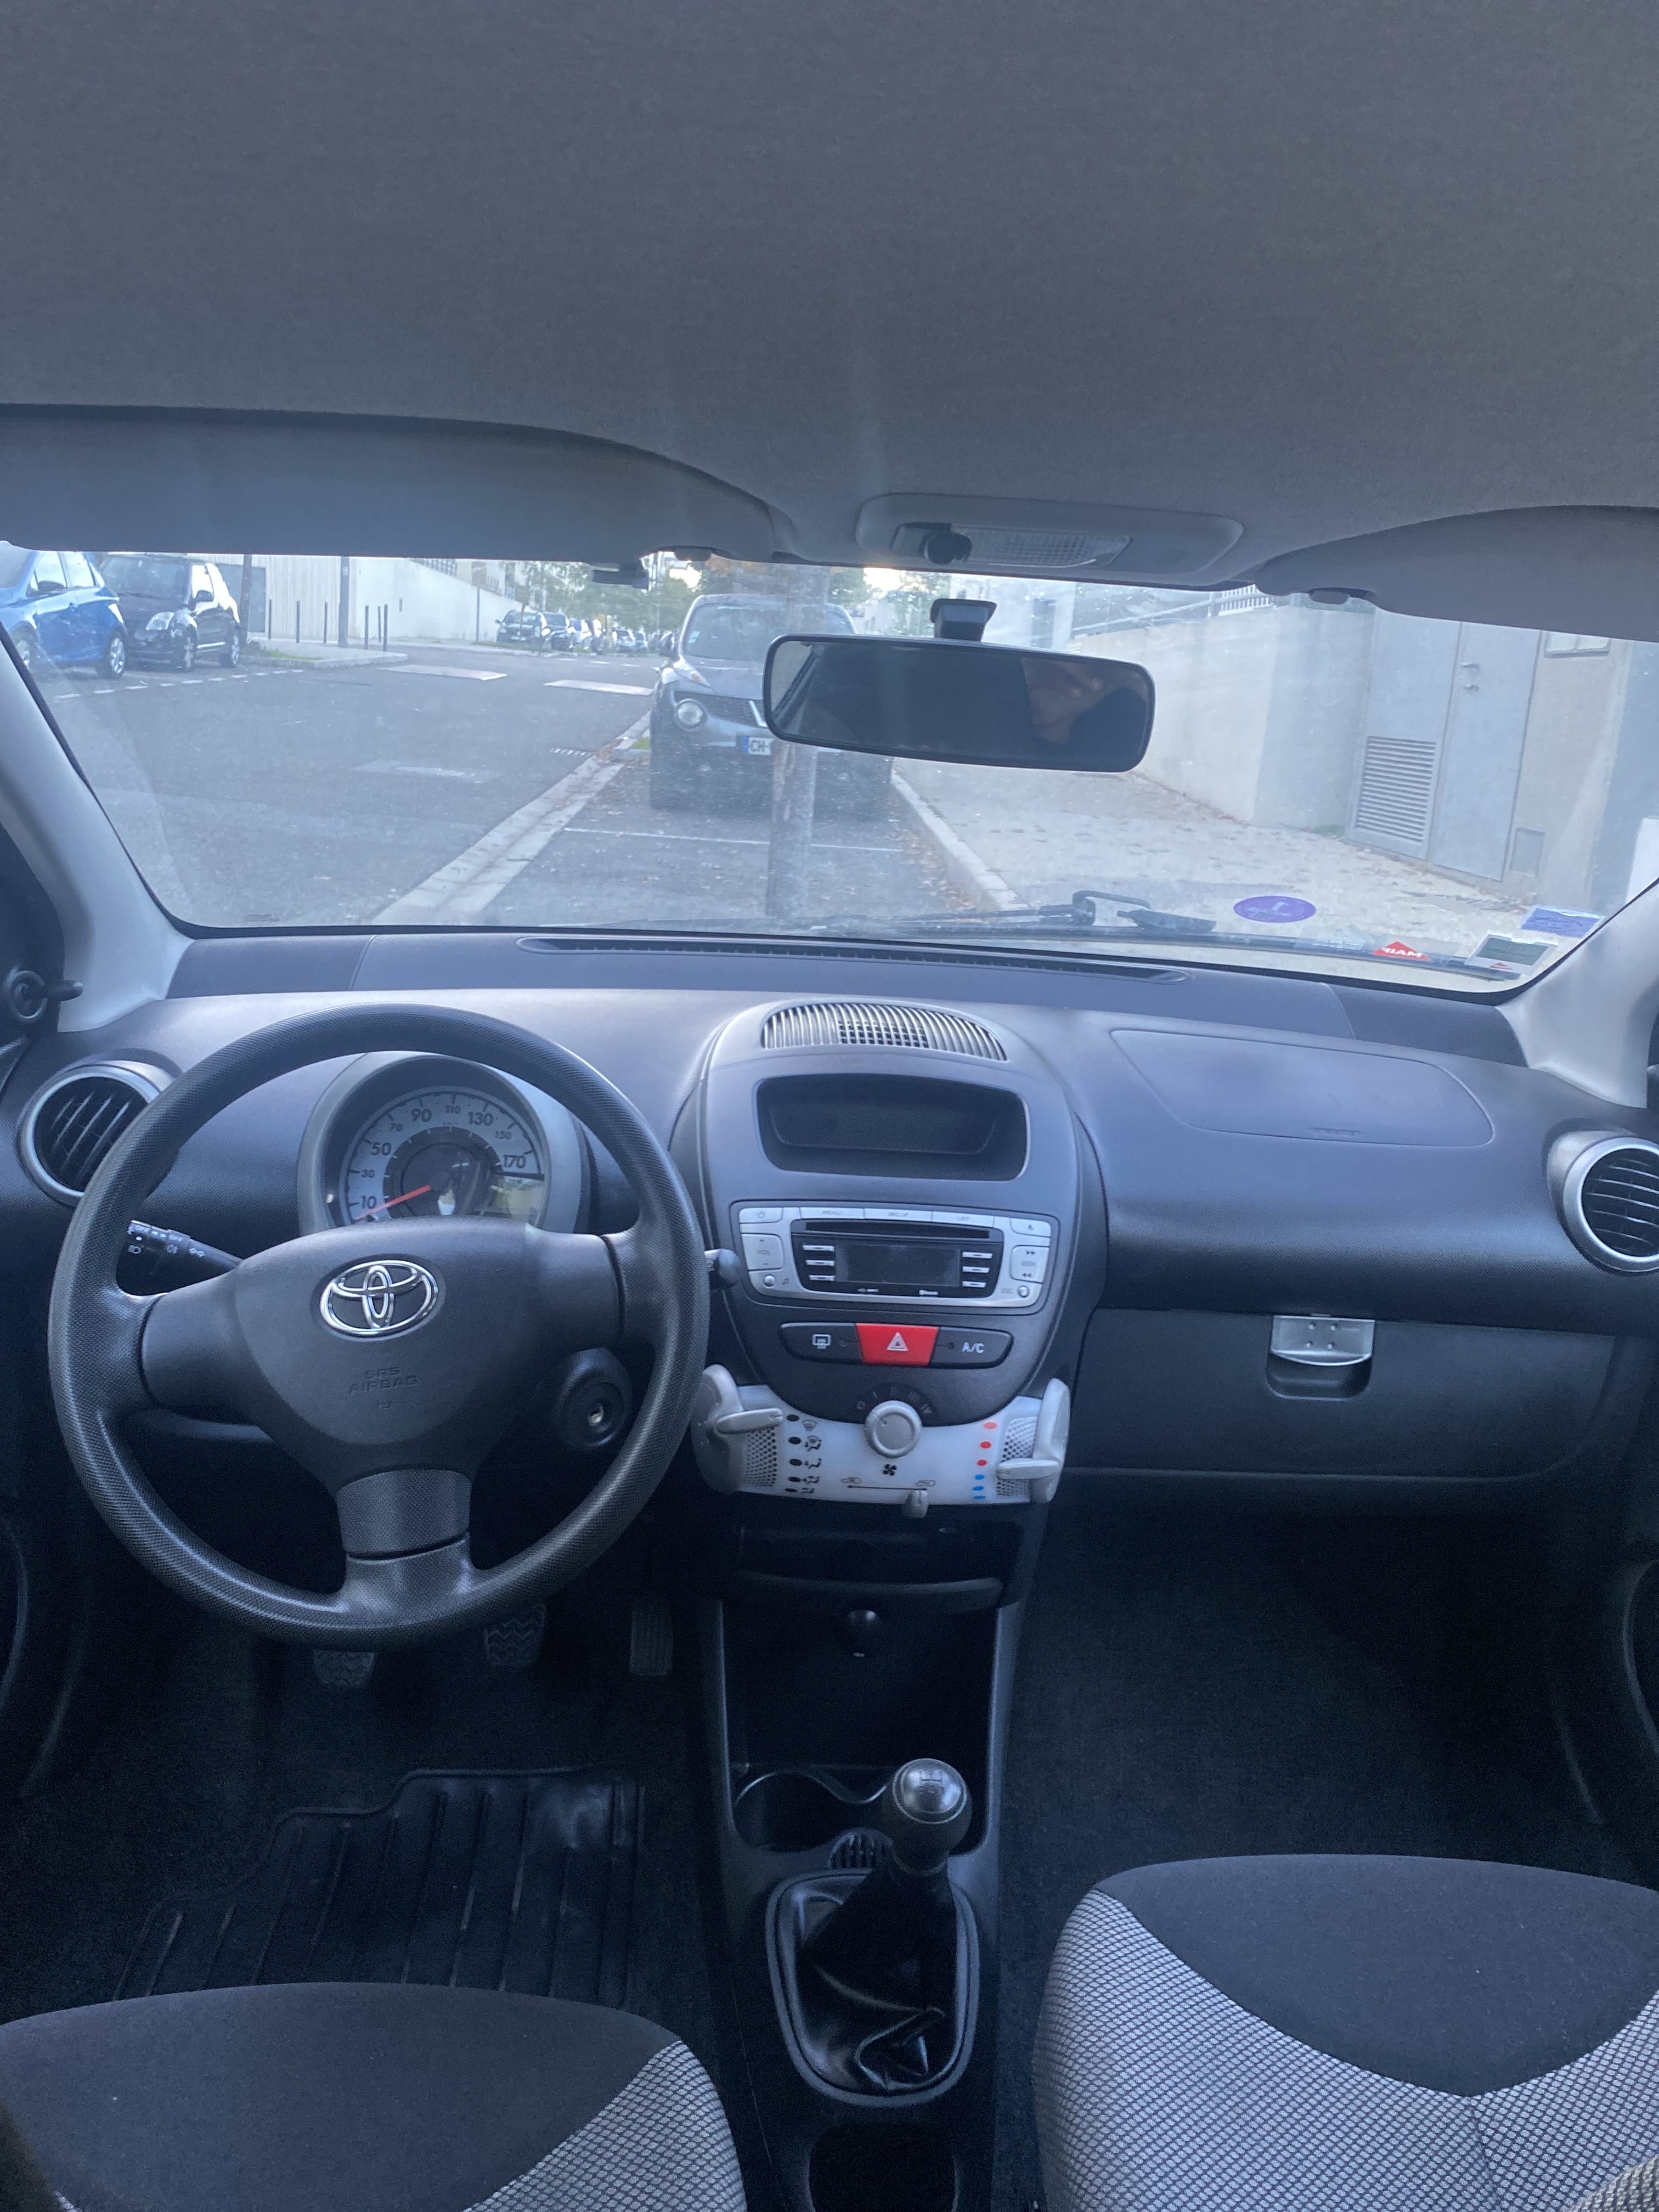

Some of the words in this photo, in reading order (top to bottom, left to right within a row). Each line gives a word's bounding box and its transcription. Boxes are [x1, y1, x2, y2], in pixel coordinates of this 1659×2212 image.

[411, 1108, 432, 1122] 90
[445, 1104, 461, 1114] 110
[467, 1111, 493, 1126] 130
[388, 1122, 404, 1132] 70
[495, 1131, 512, 1139] 150
[370, 1142, 392, 1156] 50
[503, 1154, 526, 1169] 170
[360, 1169, 375, 1178] 30
[360, 1195, 377, 1209] 10
[962, 1342, 985, 1353] A/C
[348, 1375, 418, 1394] AIRBAG
